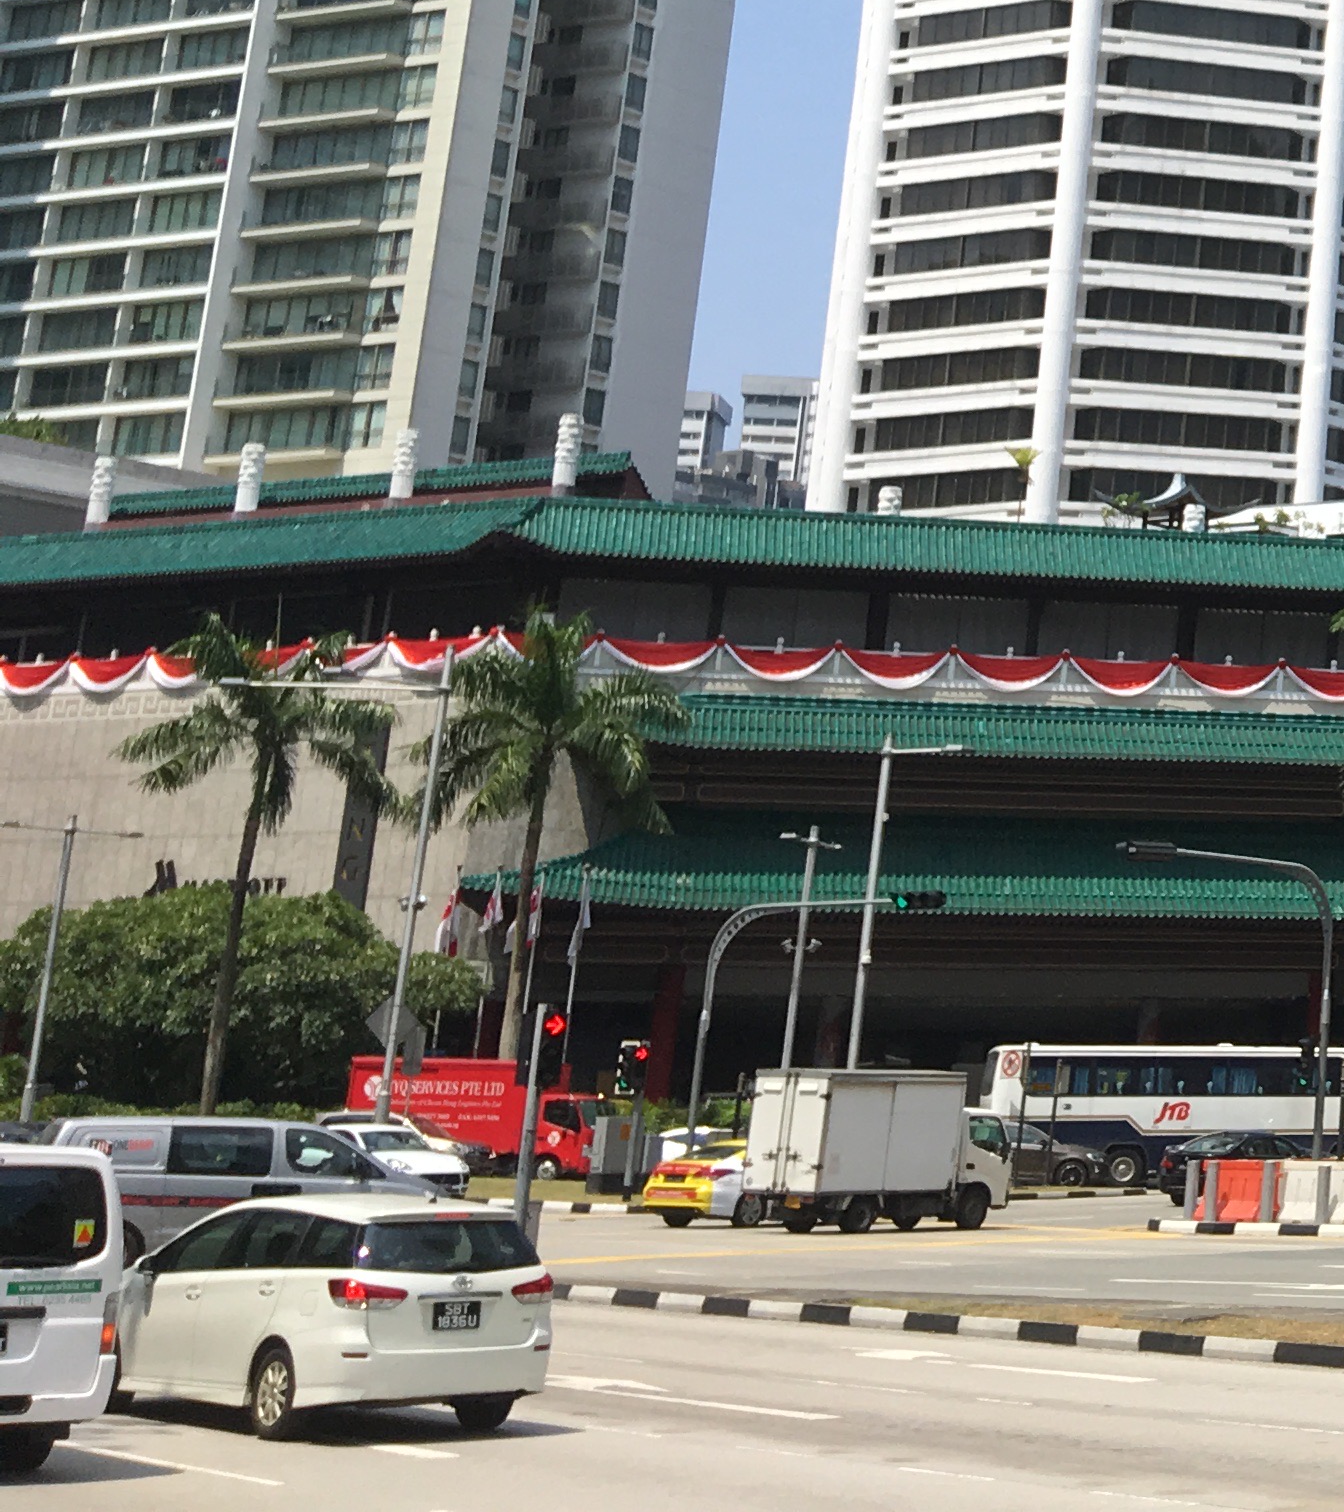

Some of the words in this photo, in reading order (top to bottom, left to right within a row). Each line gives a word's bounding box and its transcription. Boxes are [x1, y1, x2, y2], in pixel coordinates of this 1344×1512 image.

[410, 1081, 459, 1096] SERVICES
[460, 1081, 482, 1096] PTE
[483, 1082, 505, 1096] LTD
[1154, 1101, 1191, 1124] JTB
[445, 1303, 470, 1315] SBT
[438, 1315, 477, 1328] 1836U
